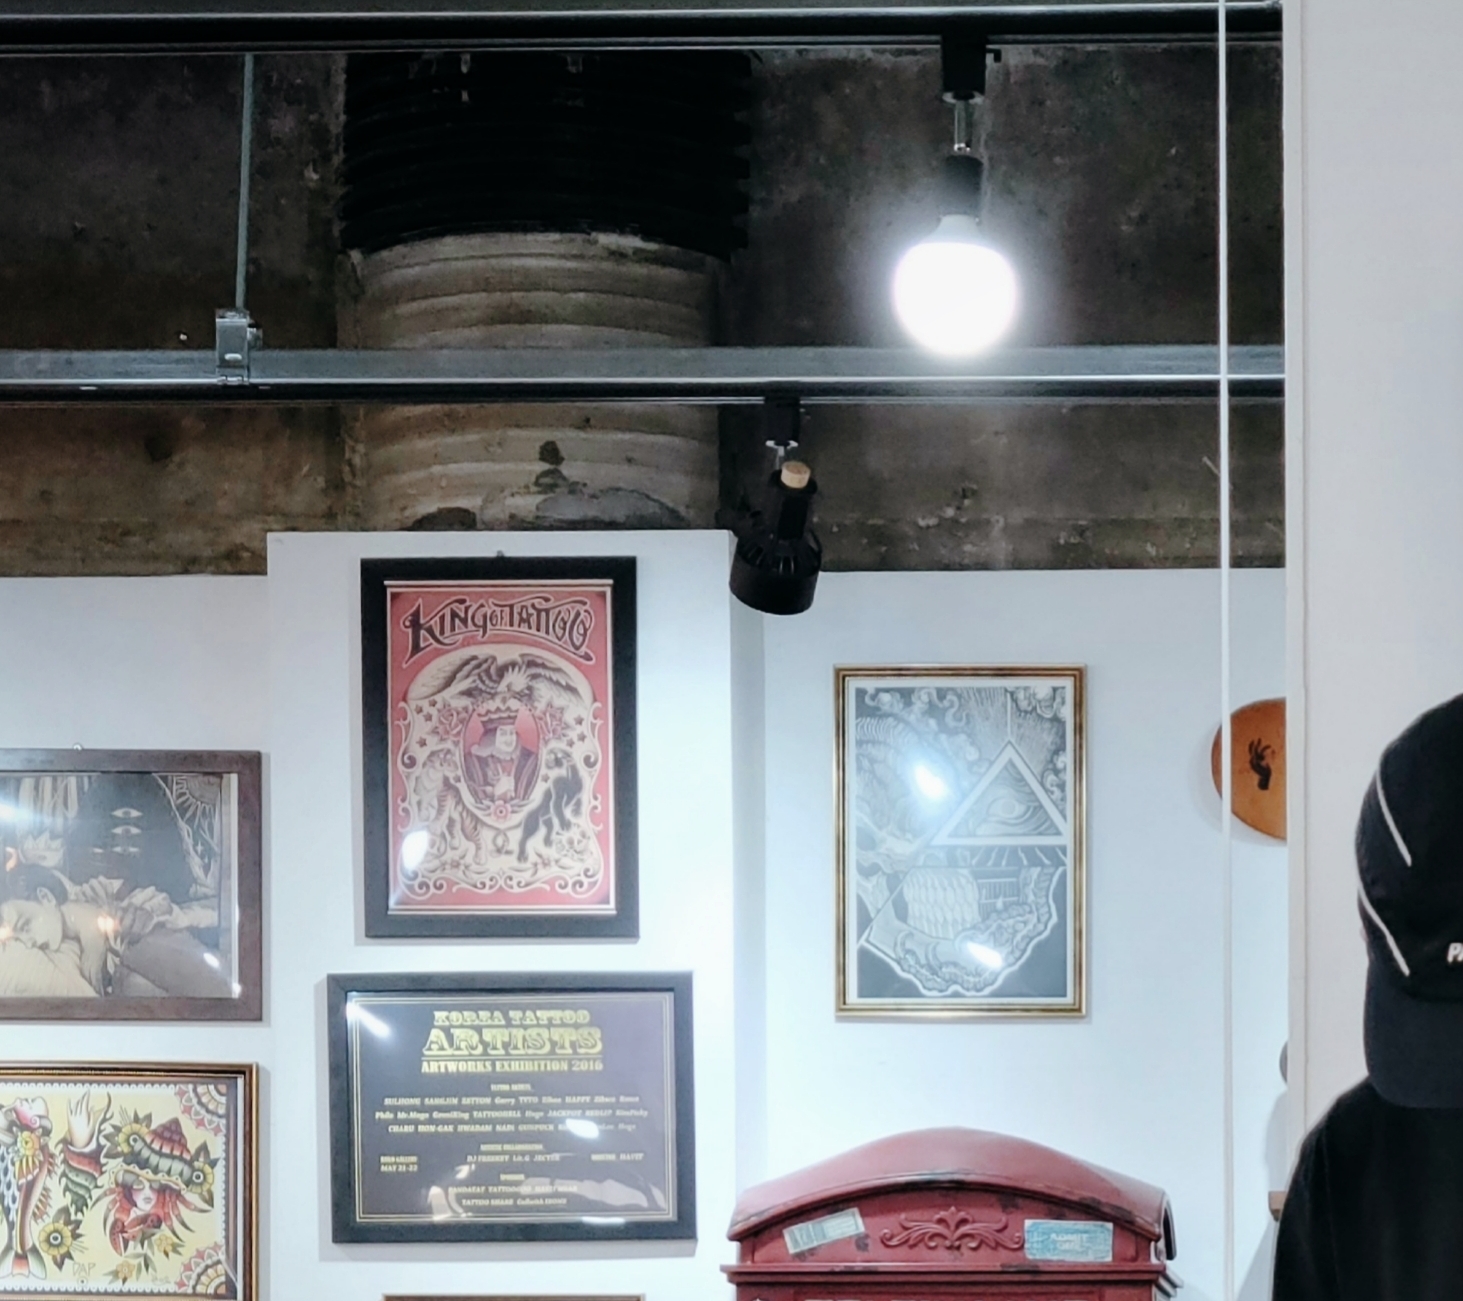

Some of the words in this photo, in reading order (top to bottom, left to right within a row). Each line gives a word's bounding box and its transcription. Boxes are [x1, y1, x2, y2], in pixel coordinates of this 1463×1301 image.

[402, 598, 488, 666] KING
[490, 594, 593, 652] TATTOO
[433, 1010, 506, 1026] KOREA
[508, 1009, 591, 1026] TATTOO
[421, 1027, 603, 1055] ARTISTS
[421, 1060, 493, 1073] ARTWORKS
[495, 1059, 569, 1073] EXHIBITION
[571, 1058, 604, 1072] 2016
